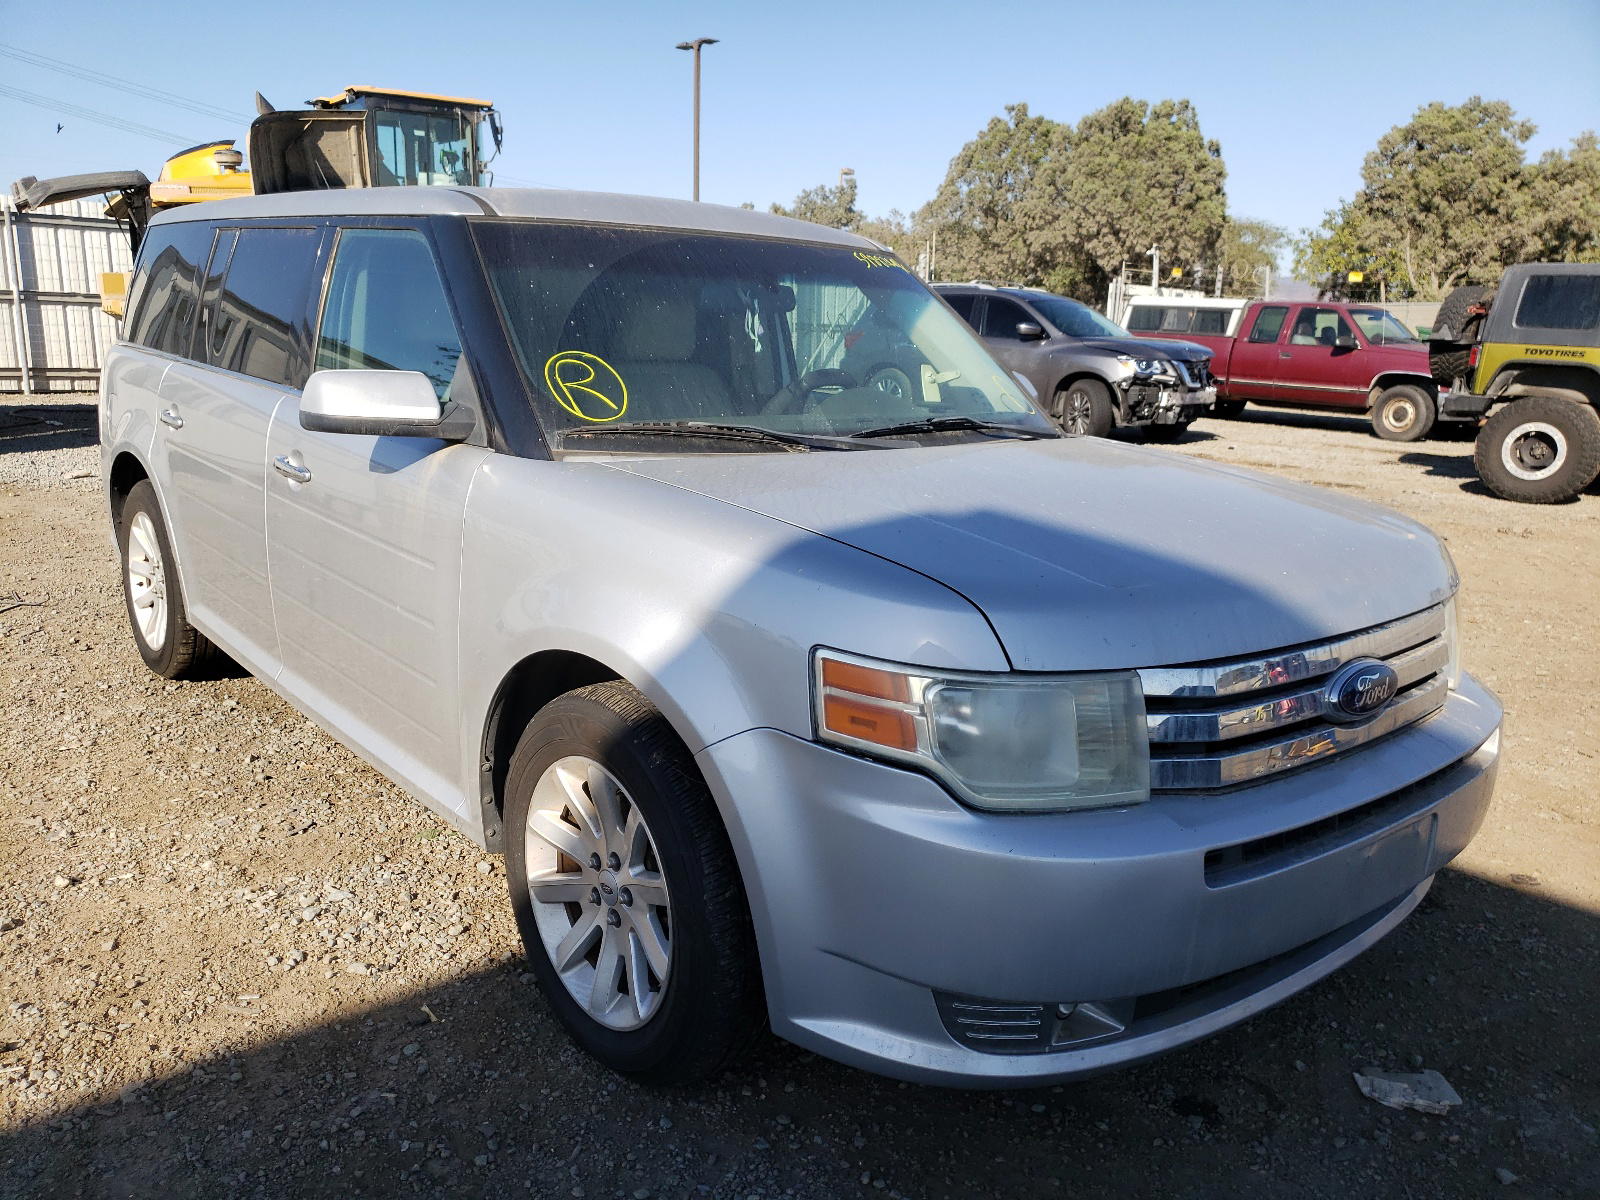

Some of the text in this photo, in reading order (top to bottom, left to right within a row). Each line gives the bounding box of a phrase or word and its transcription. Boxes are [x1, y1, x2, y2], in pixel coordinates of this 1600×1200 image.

[1525, 348, 1586, 358] TOYO TIRES
[555, 359, 619, 418] R
[1354, 673, 1390, 707] Ford
